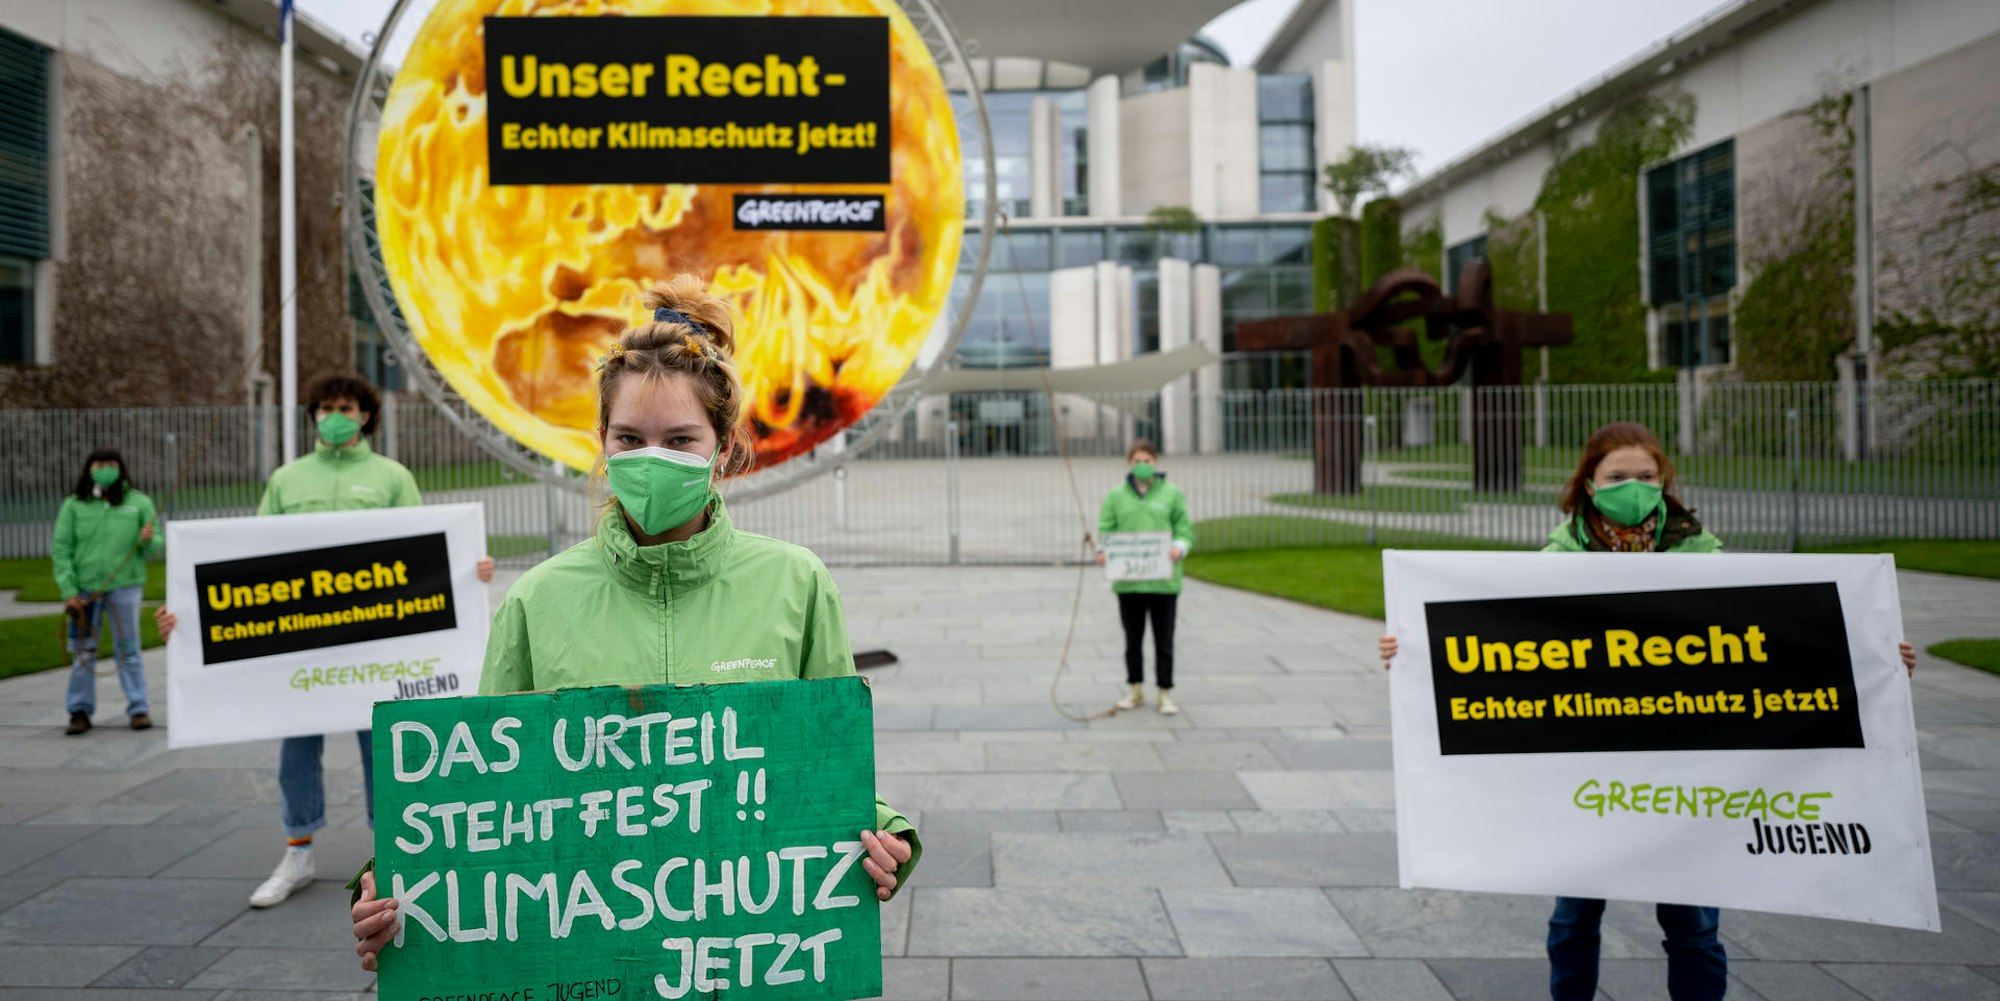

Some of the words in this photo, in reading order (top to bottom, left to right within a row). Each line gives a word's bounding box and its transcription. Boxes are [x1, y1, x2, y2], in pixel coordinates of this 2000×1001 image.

[501, 55, 654, 98] Unser
[502, 122, 602, 150] Echter
[608, 121, 792, 149] Klimaschutz
[797, 121, 877, 154] jetzt!
[738, 199, 880, 226] GREENPEACE
[207, 578, 305, 610] Unser
[311, 560, 408, 597] Recht
[209, 619, 275, 642] Echter
[279, 602, 394, 633] Klimaschutz
[396, 593, 446, 620] jetzt!
[710, 658, 777, 673] GREENPEACE
[1445, 636, 1593, 674] Unser
[1606, 625, 1768, 668] Recht
[289, 657, 441, 691] GREENPEACE
[394, 673, 459, 700] JUGEND
[1451, 696, 1547, 720] Echter
[1554, 690, 1746, 718] Klimaschutz
[1754, 687, 1840, 719] jetzt!
[390, 717, 522, 783] DAS
[552, 706, 765, 772] URTEIL
[395, 797, 573, 854] STEHT
[578, 778, 712, 838] FEST
[736, 768, 767, 822] !!
[1573, 779, 1833, 822] GREENPEACE
[1746, 817, 1872, 856] JUGEND
[392, 841, 865, 948] KLIMASCHUTZ
[653, 928, 843, 1000] JETZT
[546, 978, 622, 1001] JUGEND
